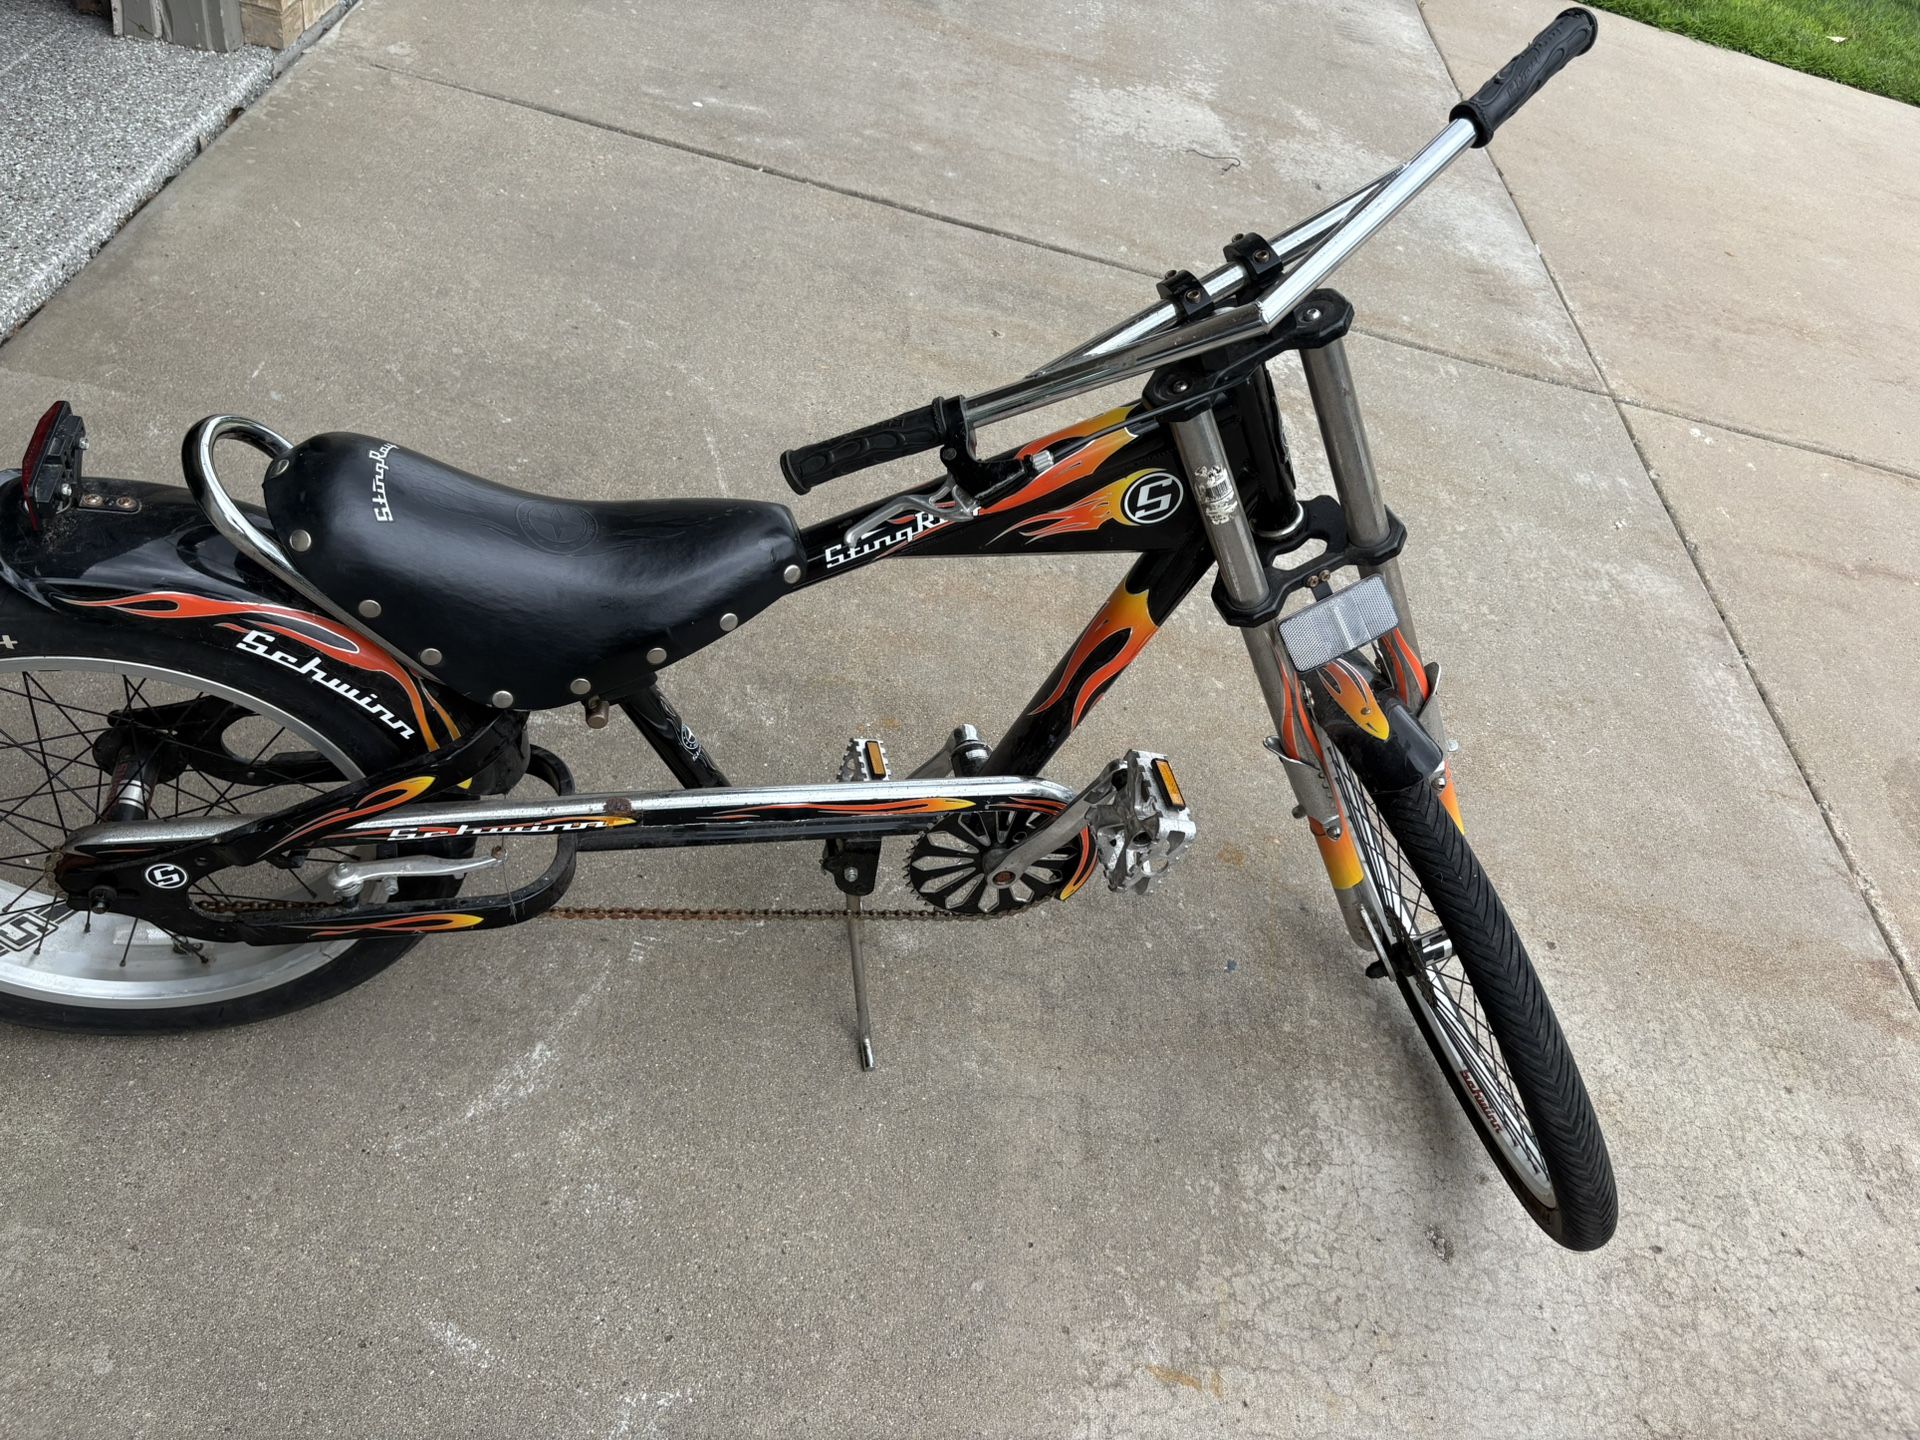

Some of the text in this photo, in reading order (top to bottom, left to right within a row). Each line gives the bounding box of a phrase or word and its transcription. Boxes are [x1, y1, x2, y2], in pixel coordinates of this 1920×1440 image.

[368, 442, 400, 521] StingRay
[1134, 477, 1173, 519] S
[825, 508, 949, 568] StingR
[236, 630, 416, 740] Schwinn
[386, 822, 608, 842] Schwinn
[153, 865, 181, 886] S
[1460, 1069, 1502, 1134] Schwinn
